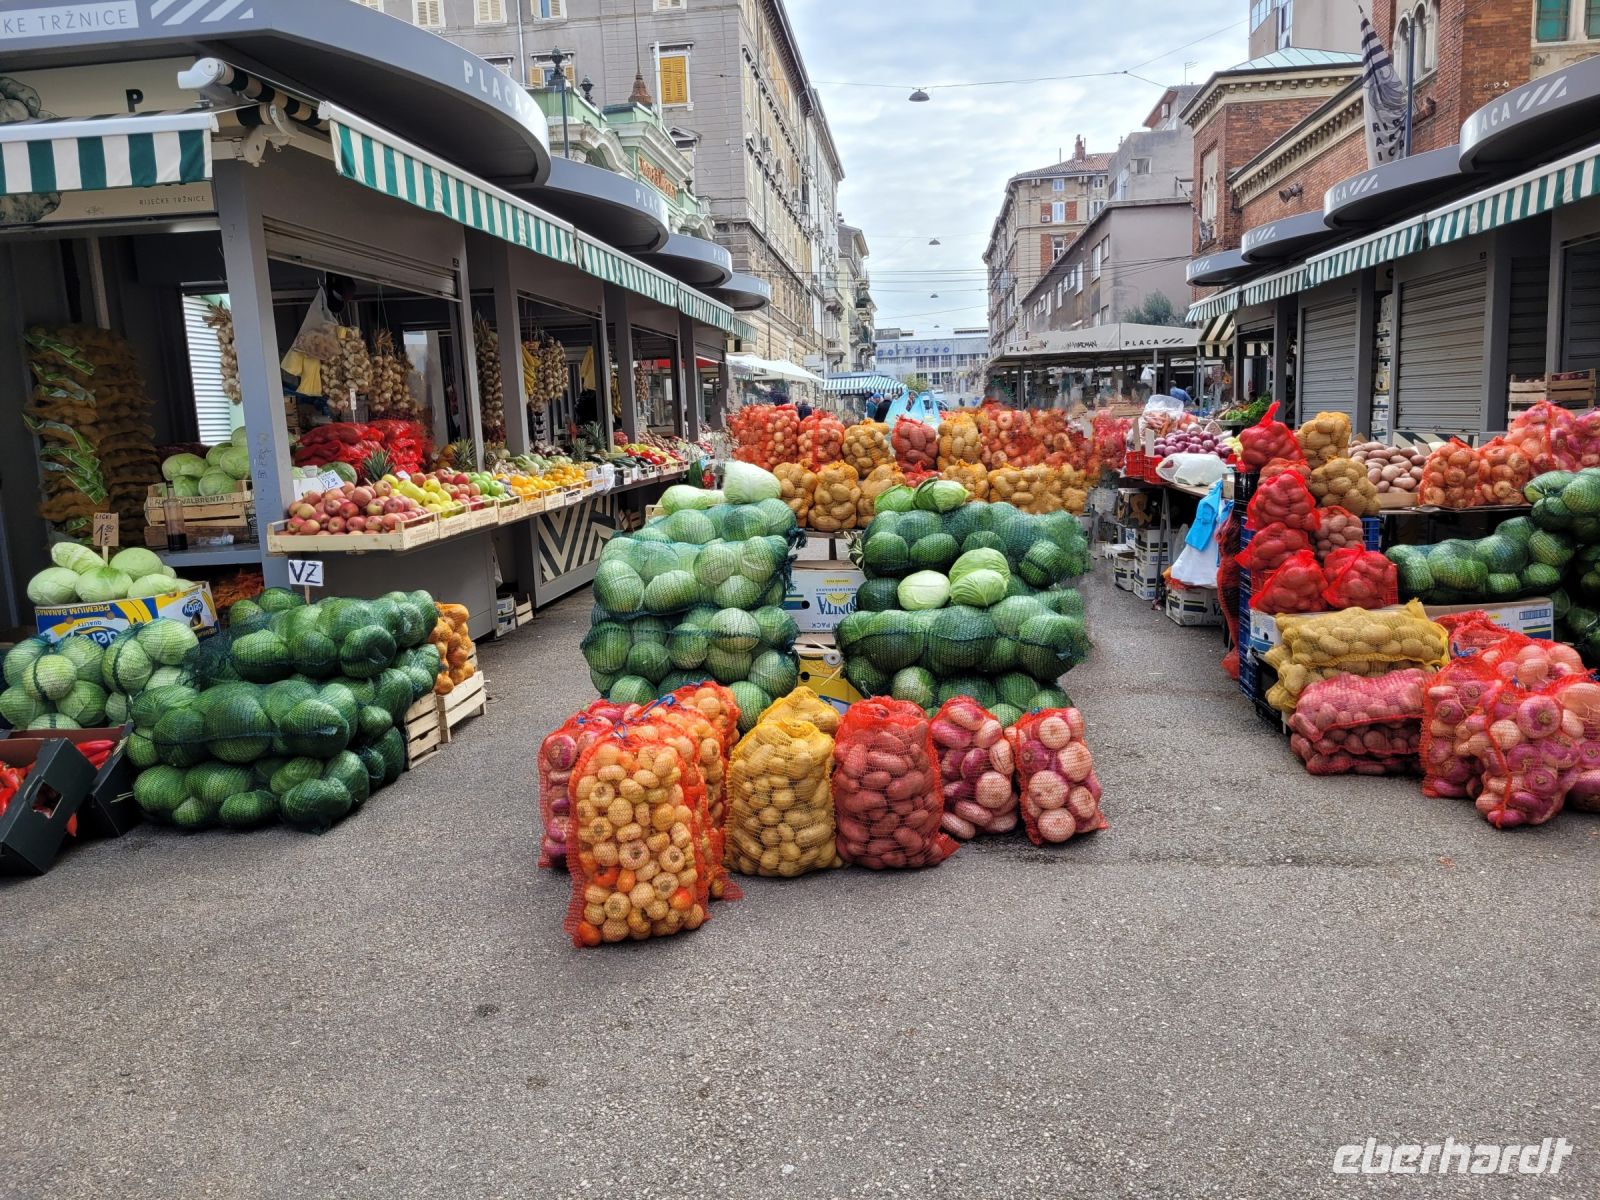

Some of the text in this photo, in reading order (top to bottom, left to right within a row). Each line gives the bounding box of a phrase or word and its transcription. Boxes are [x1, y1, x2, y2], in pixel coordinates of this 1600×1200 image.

[2, 8, 128, 33] KE TRŽNICE
[463, 59, 522, 115] PLACA
[1125, 338, 1159, 347] PLACA
[289, 561, 321, 583] VZ
[35, 604, 111, 616] PREMIUM BANANAS
[77, 620, 102, 628] QUALITY
